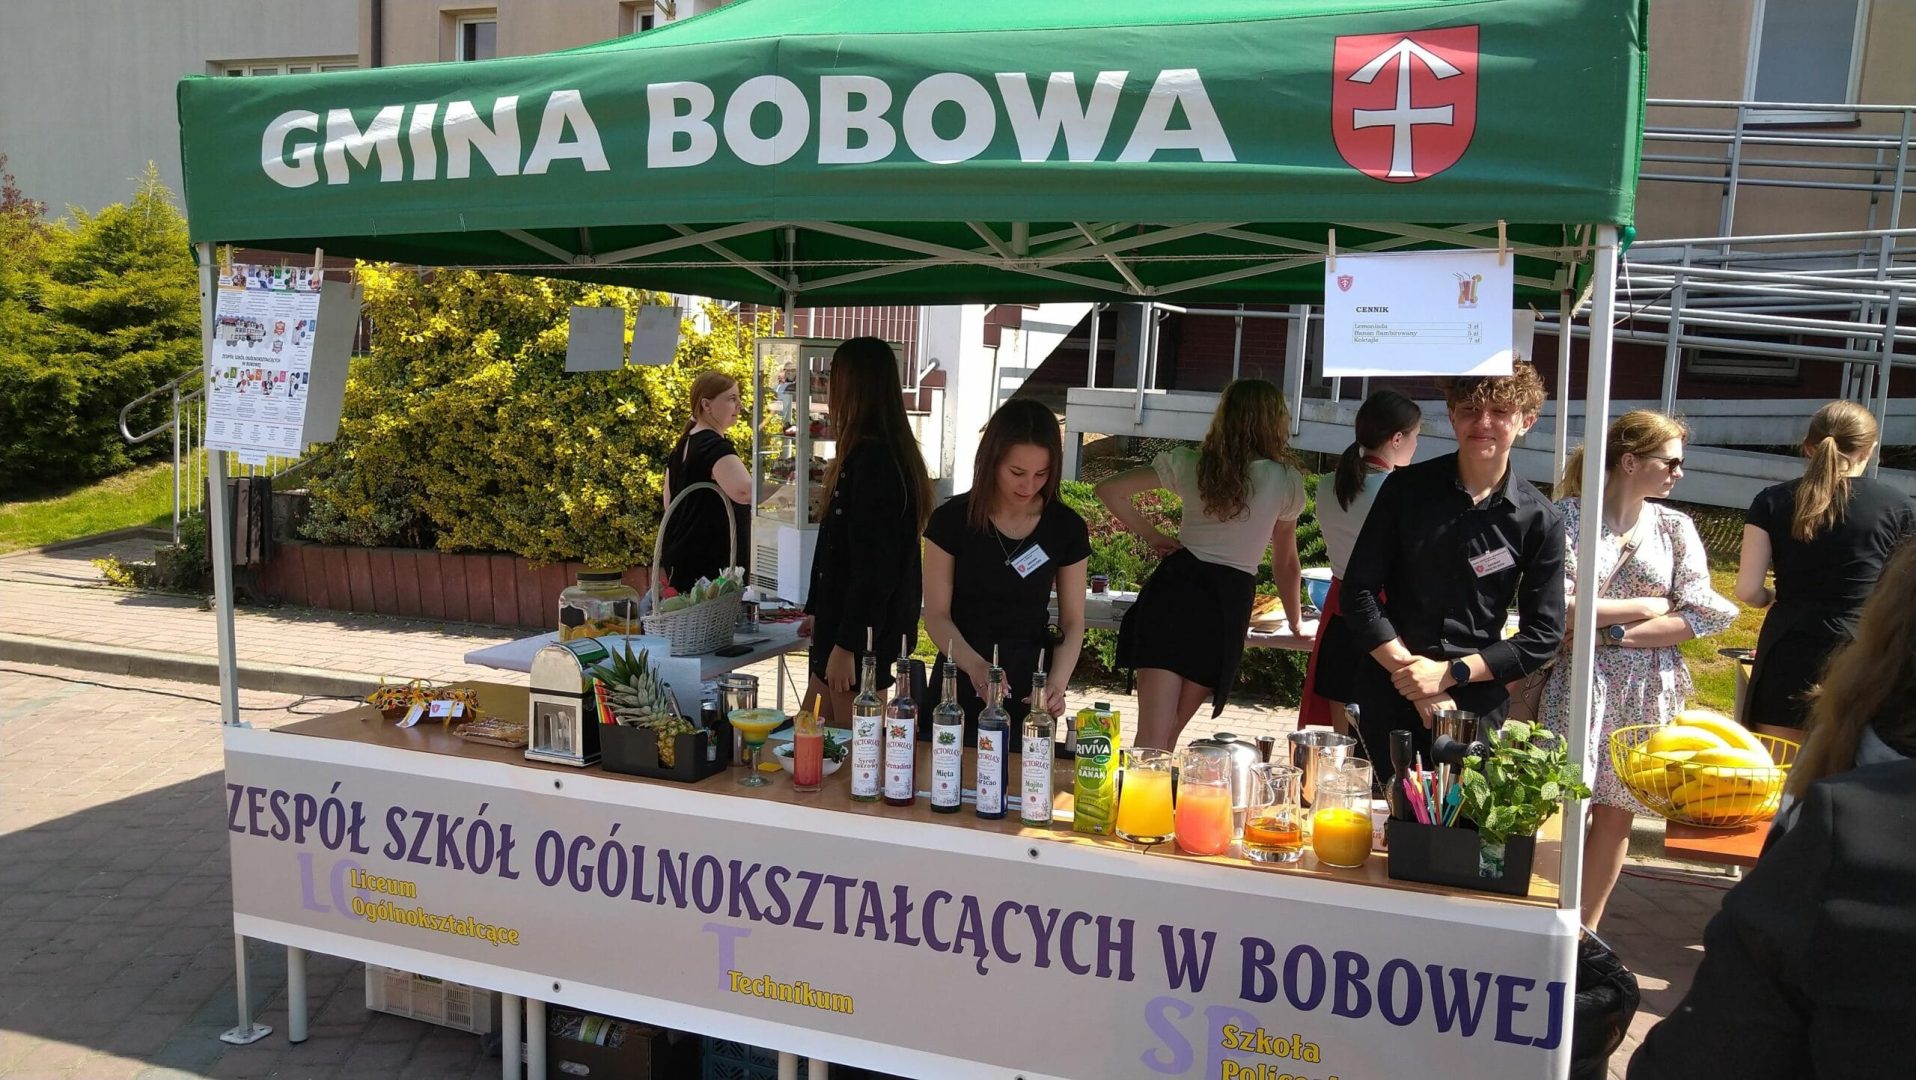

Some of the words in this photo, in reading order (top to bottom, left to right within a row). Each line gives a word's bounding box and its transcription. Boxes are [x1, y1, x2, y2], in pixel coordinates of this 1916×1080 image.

[262, 89, 611, 188] GMINA
[646, 68, 1238, 168] BOBOWA
[1076, 741, 1110, 755] RIVIVA
[936, 769, 954, 780] Mięta
[297, 852, 371, 920] LO
[350, 869, 418, 899] Liceum
[227, 781, 370, 856] ZESPÓŁ
[383, 802, 520, 881] SZKÓŁ
[534, 823, 1136, 983] OGÓLNOKSZTAŁCĄCYCH
[1157, 924, 1218, 995] W
[1238, 936, 1568, 1051] BOBOWEJ
[352, 897, 520, 947] Ogólnokształcące
[702, 924, 753, 992] T
[727, 970, 855, 1014] Technikum
[1221, 1023, 1322, 1064] Szkoła
